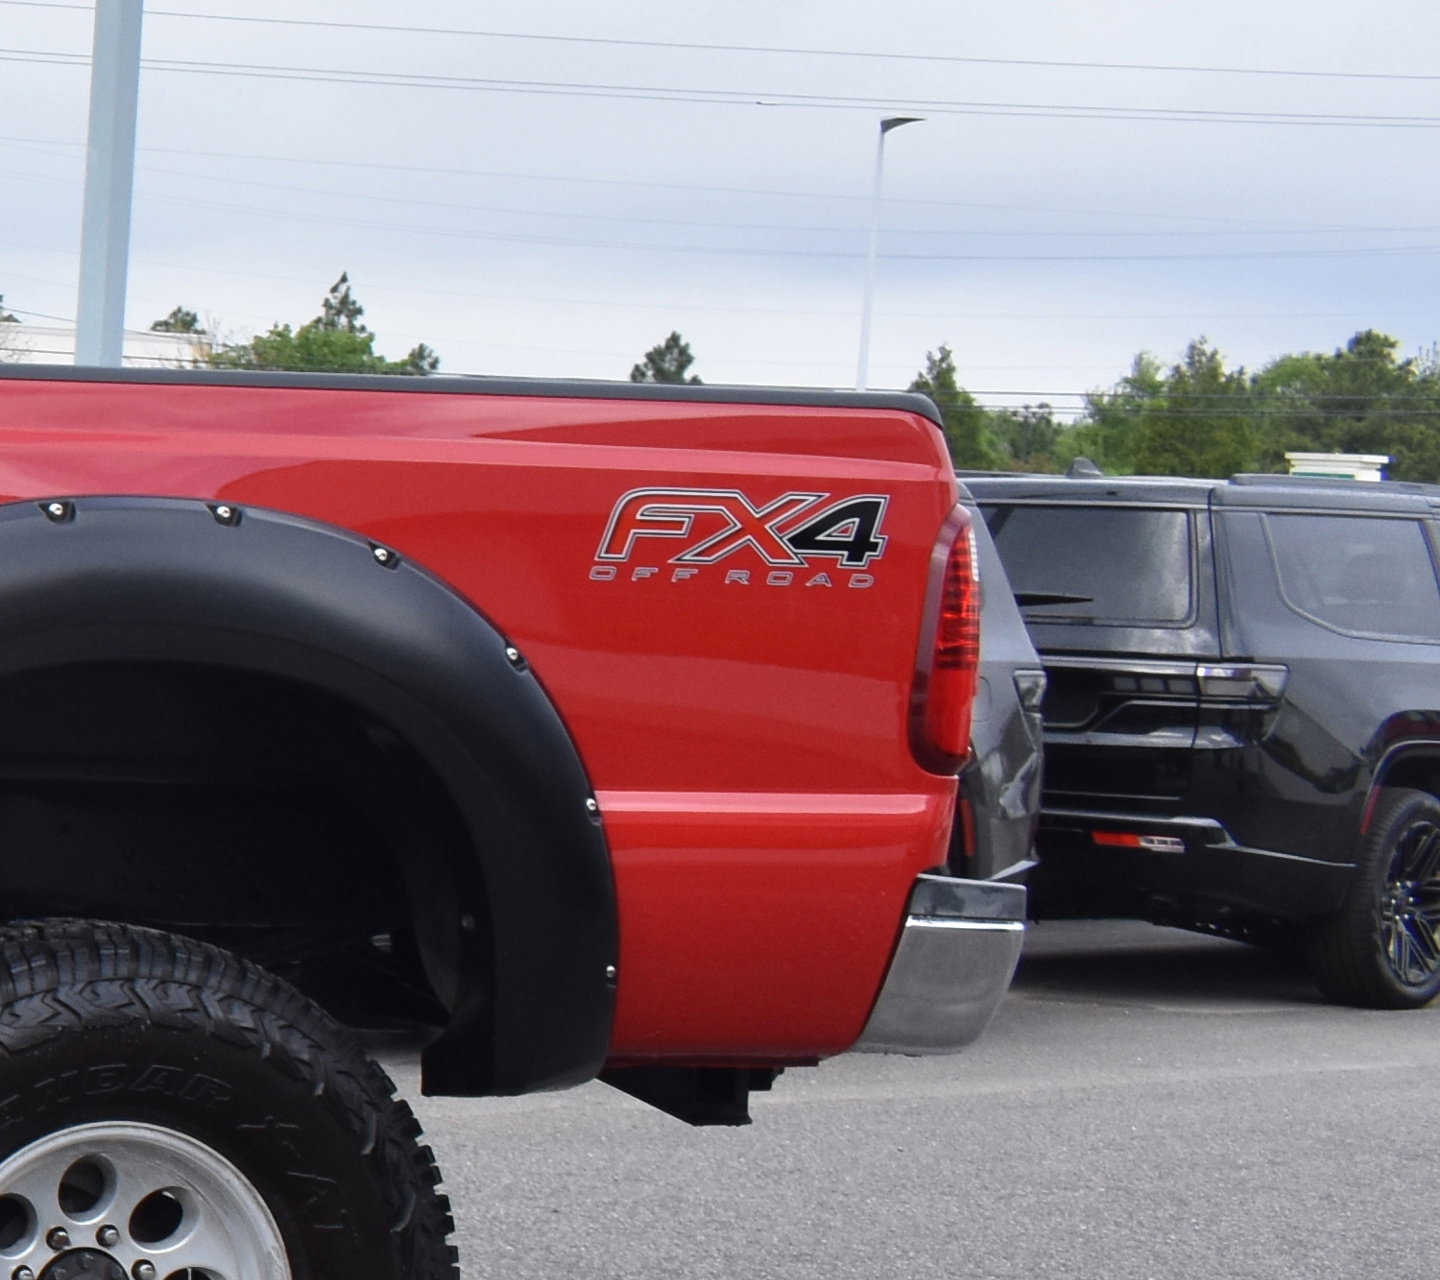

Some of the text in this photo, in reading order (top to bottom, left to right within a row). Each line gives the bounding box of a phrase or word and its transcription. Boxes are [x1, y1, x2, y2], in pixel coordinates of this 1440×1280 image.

[594, 486, 891, 569] FX4
[588, 565, 874, 588] OFF ROAD
